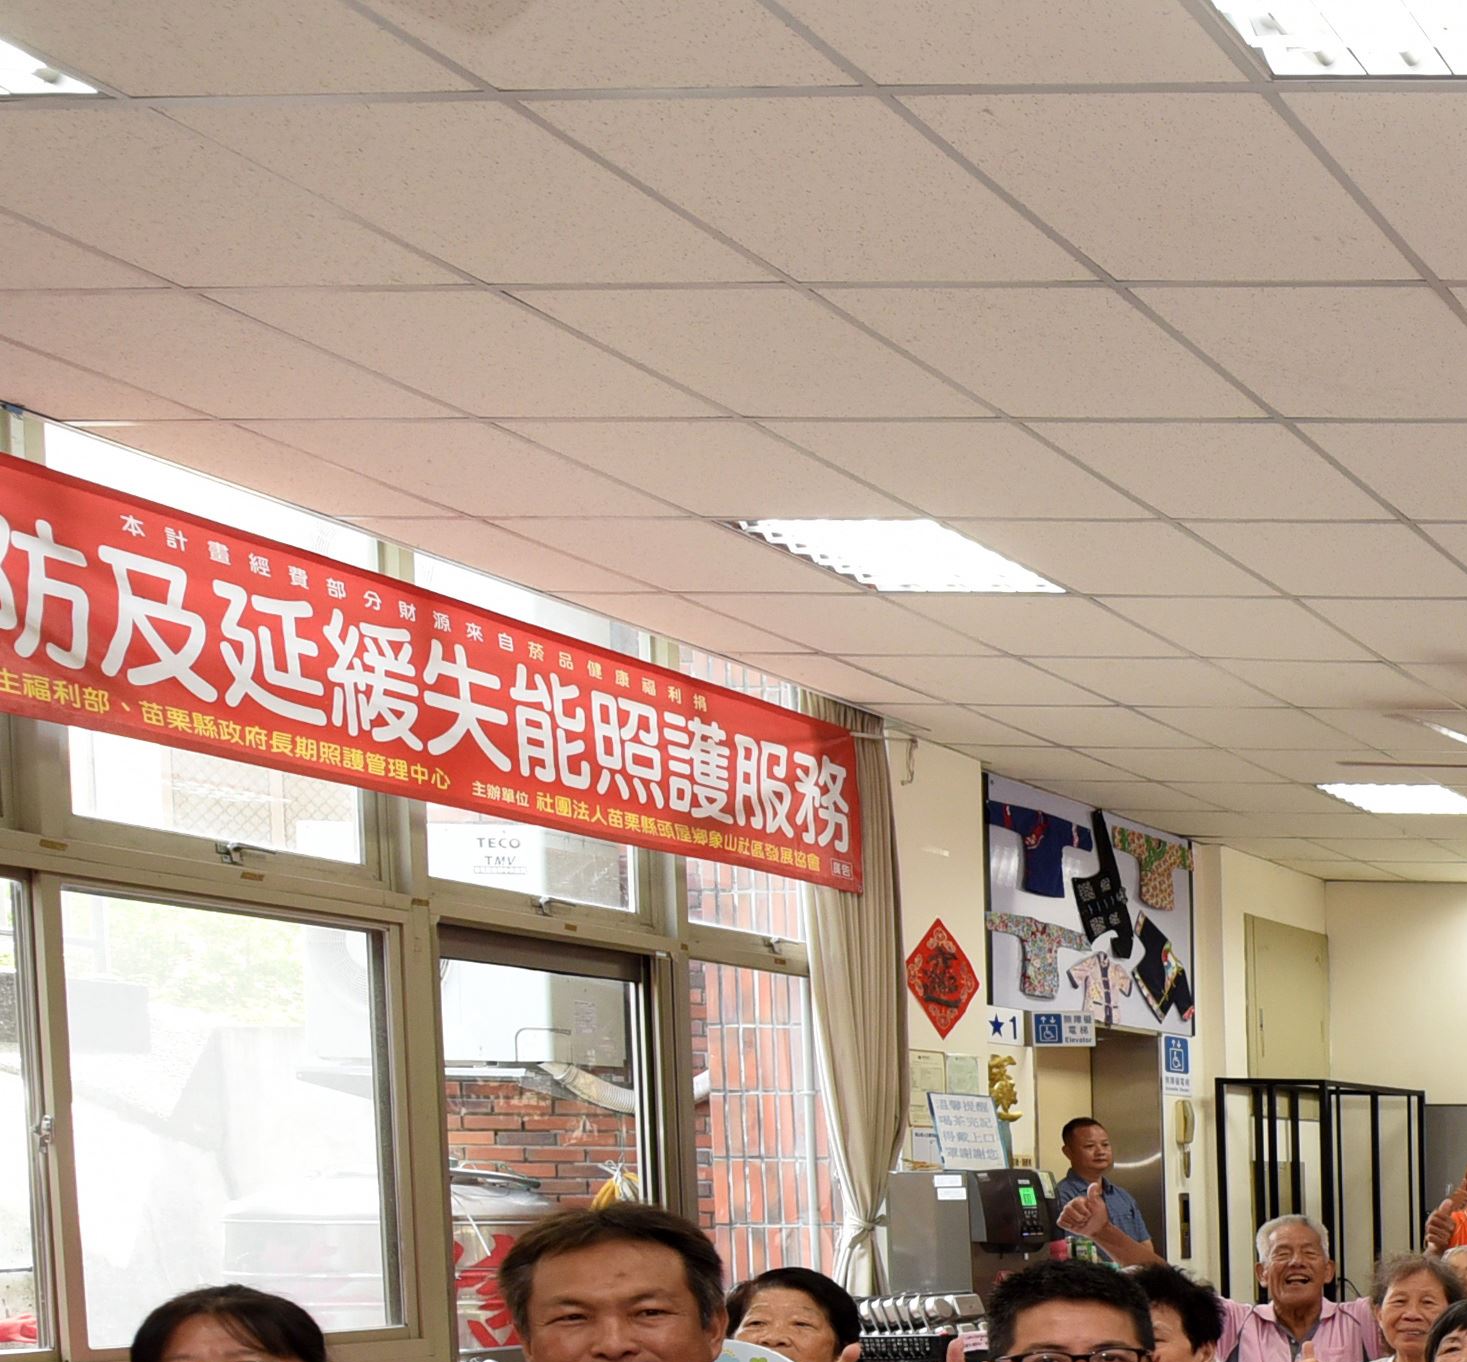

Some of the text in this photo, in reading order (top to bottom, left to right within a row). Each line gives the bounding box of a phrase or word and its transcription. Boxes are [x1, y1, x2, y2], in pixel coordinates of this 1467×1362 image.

[119, 514, 708, 713] 本計畫經費部分財源來自菸品健康福利捐
[472, 780, 530, 808] 主辦單位
[536, 791, 821, 873] 社團法人苗栗縣頭屋鄉象山社區發展協會
[476, 837, 521, 848] TECO
